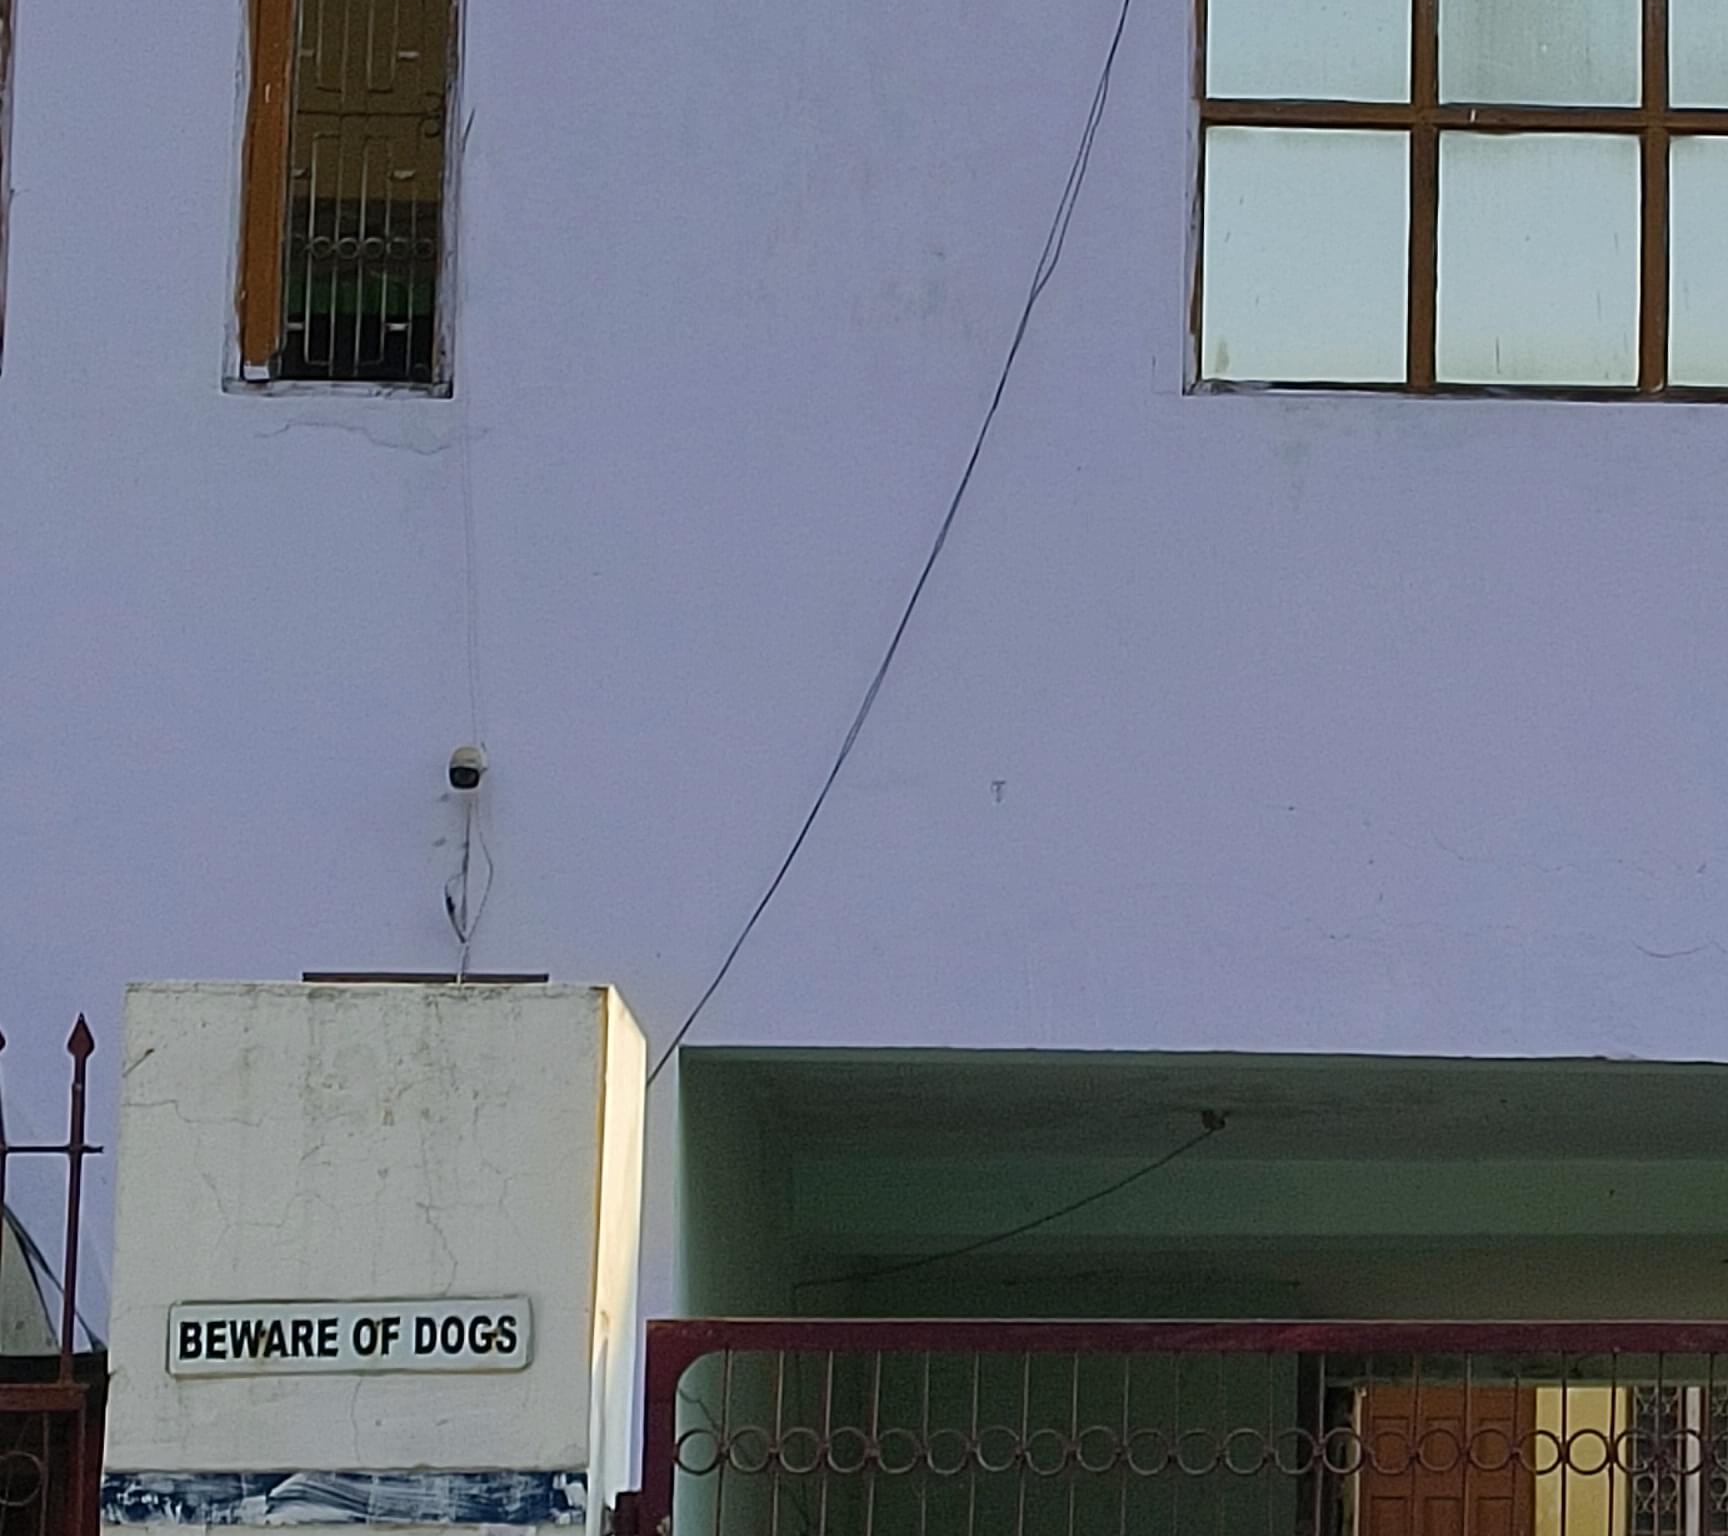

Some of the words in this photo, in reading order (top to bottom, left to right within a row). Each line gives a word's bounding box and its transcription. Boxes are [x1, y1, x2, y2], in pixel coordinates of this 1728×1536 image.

[178, 1317, 339, 1360] BEWARE
[352, 1317, 401, 1356] OF
[414, 1315, 518, 1355] DOGS
